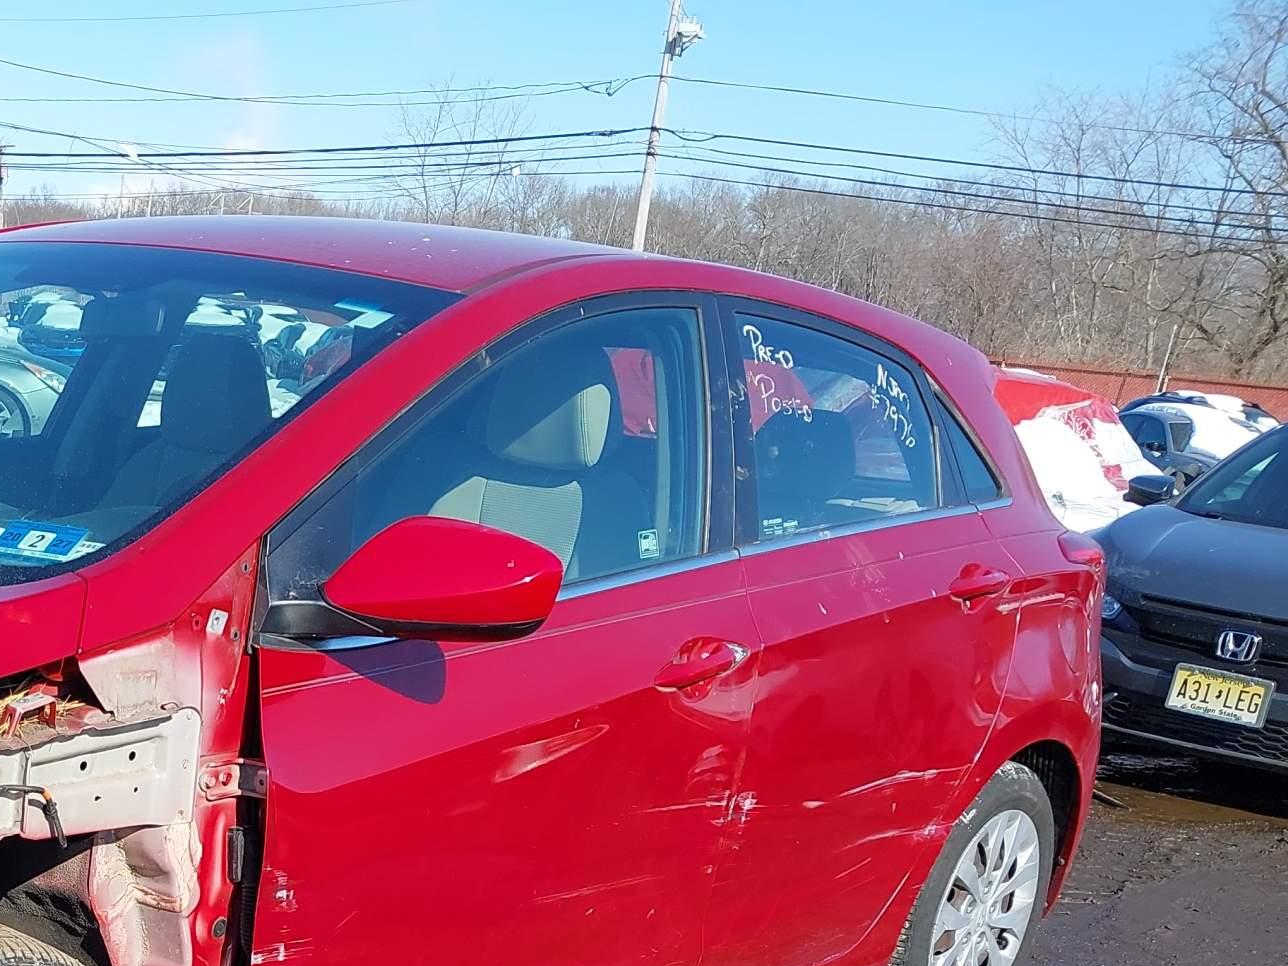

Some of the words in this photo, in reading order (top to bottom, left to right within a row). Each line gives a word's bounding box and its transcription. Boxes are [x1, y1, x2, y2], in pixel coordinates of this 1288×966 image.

[2, 531, 22, 542] 20
[28, 534, 45, 548] 2
[52, 538, 74, 549] 27
[1190, 703, 1216, 714] Garden
[1219, 709, 1239, 719] State
